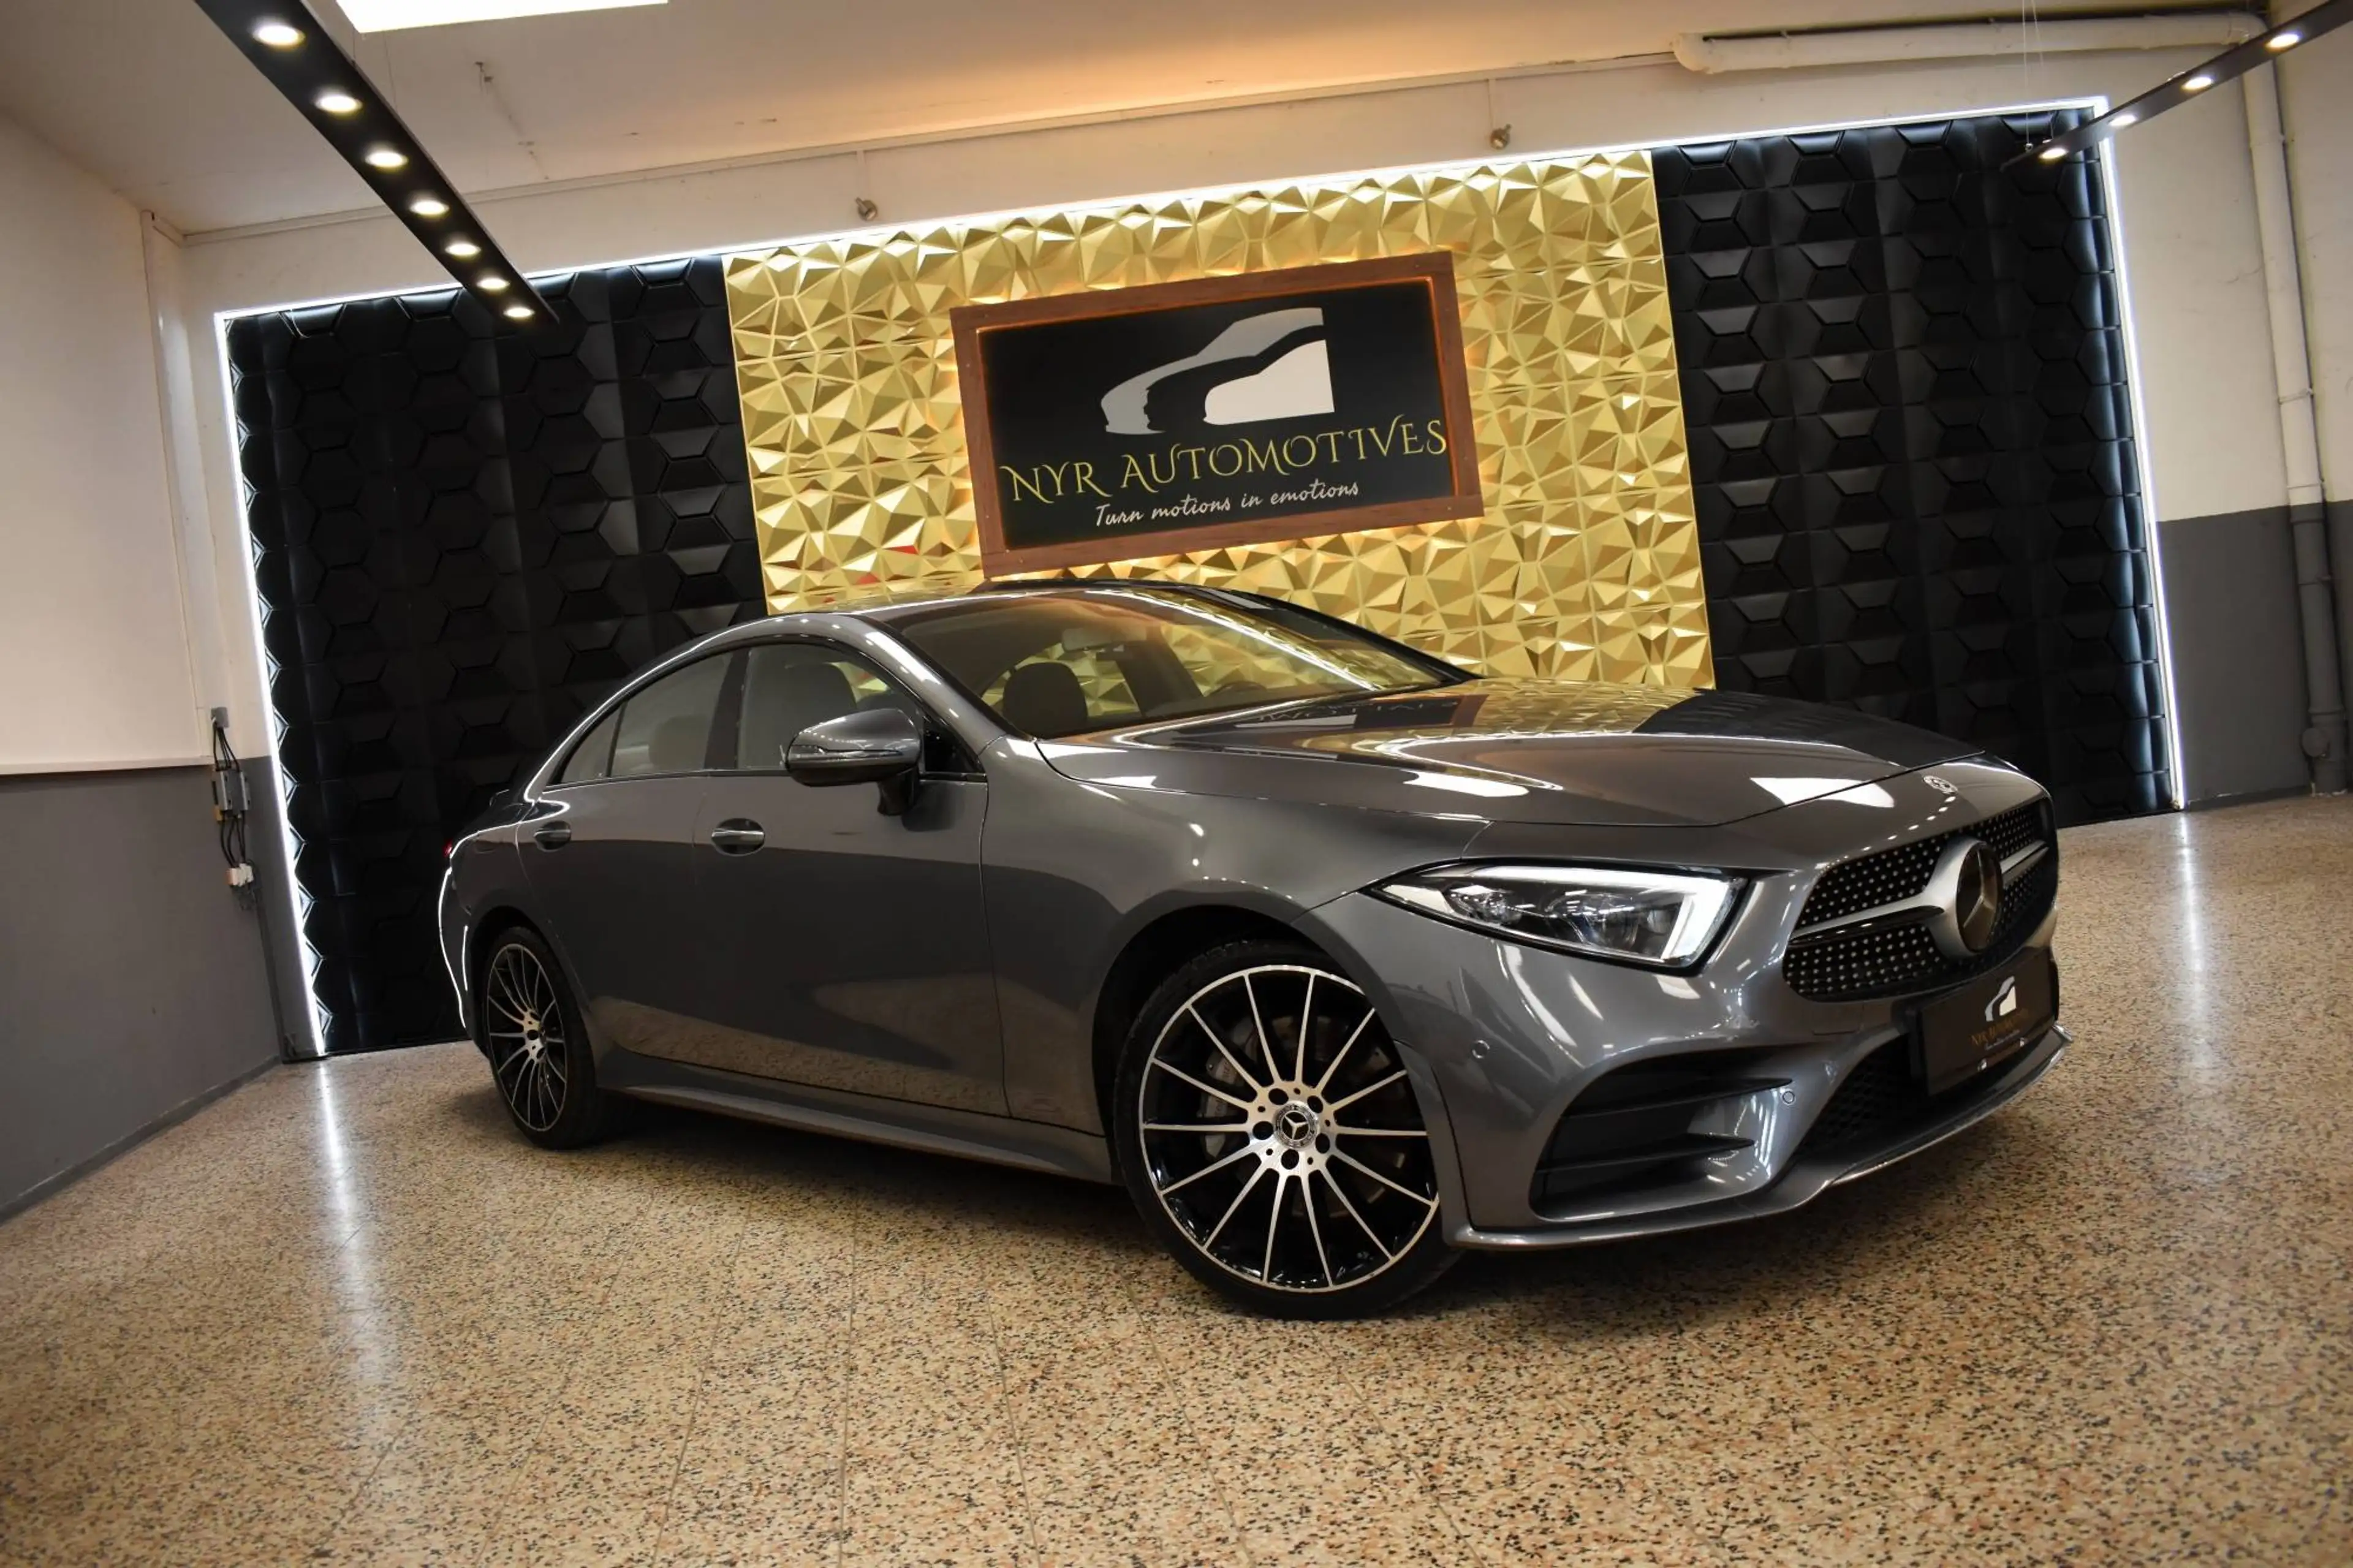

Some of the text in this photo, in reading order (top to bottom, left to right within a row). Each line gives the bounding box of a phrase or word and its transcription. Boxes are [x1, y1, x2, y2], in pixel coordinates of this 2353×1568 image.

[999, 414, 1447, 503] NYR AUTOMOTIVES
[1095, 478, 1359, 527] Turn motions in emotions
